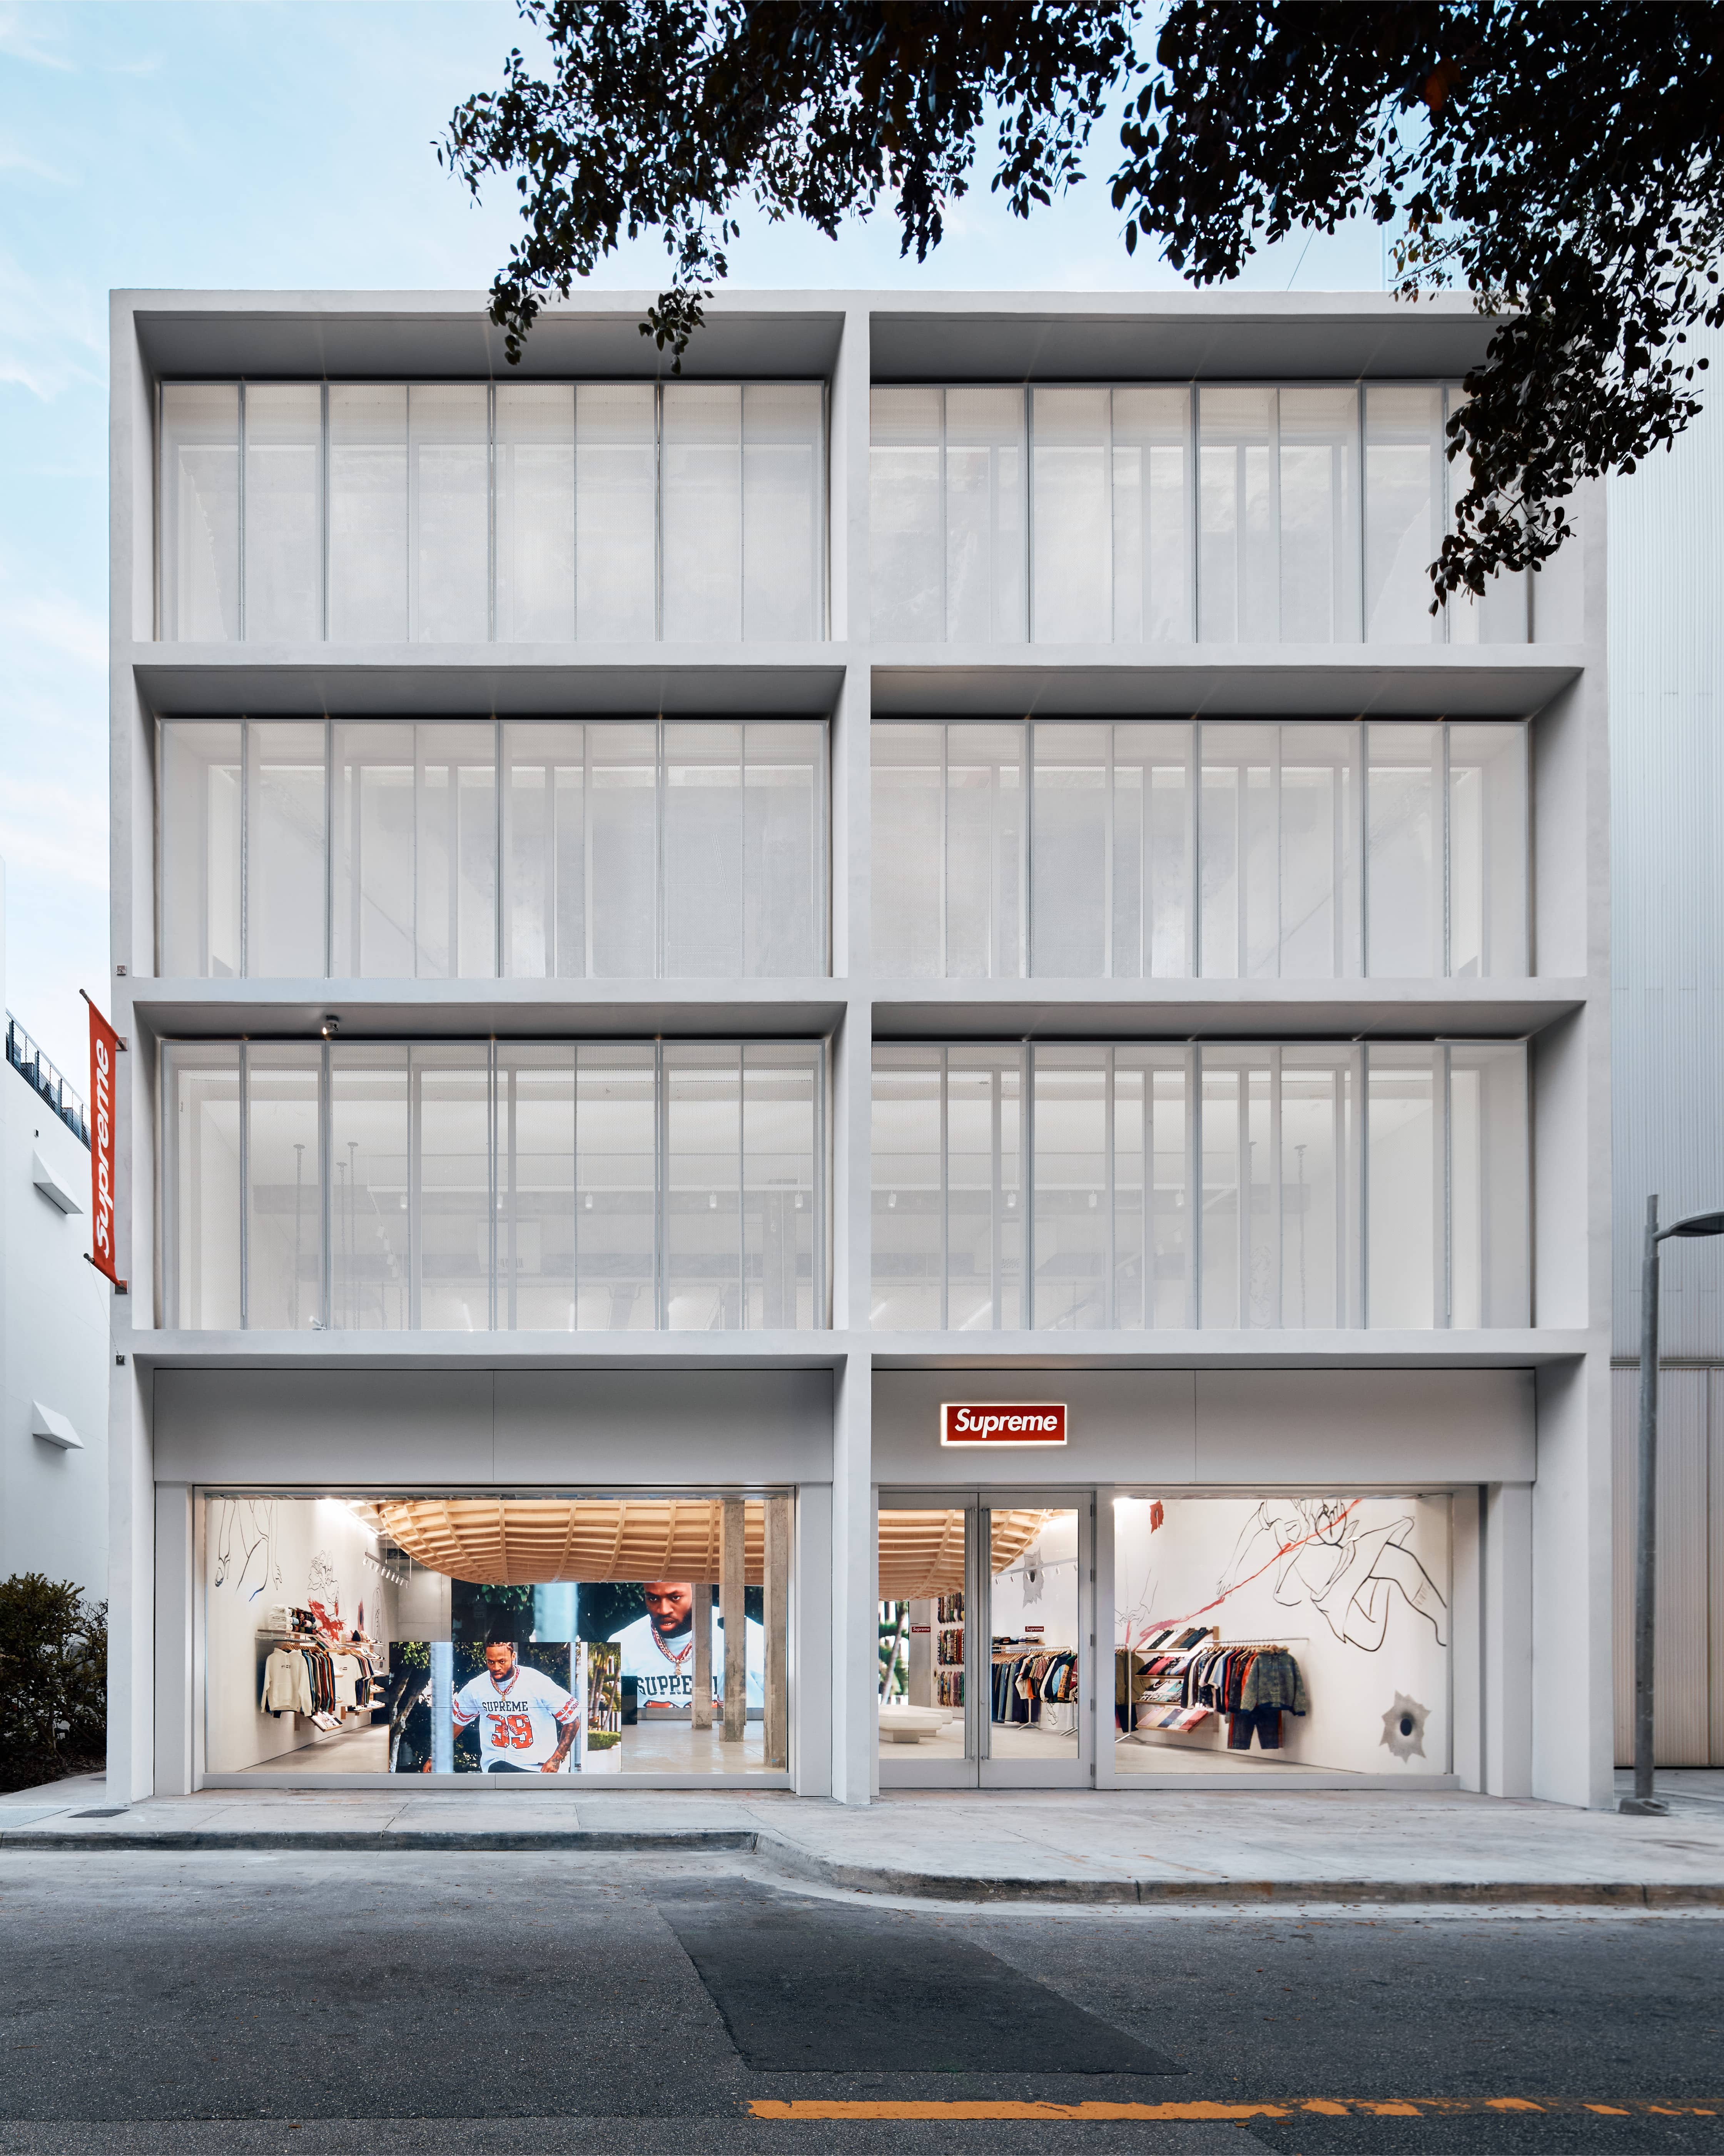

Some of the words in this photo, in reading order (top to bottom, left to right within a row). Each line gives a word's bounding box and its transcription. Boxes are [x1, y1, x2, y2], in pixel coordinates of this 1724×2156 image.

[96, 1039, 113, 1259] Supreme
[954, 1408, 1057, 1438] Supreme
[482, 1701, 528, 1712] SUPREME
[486, 1714, 533, 1749] 39
